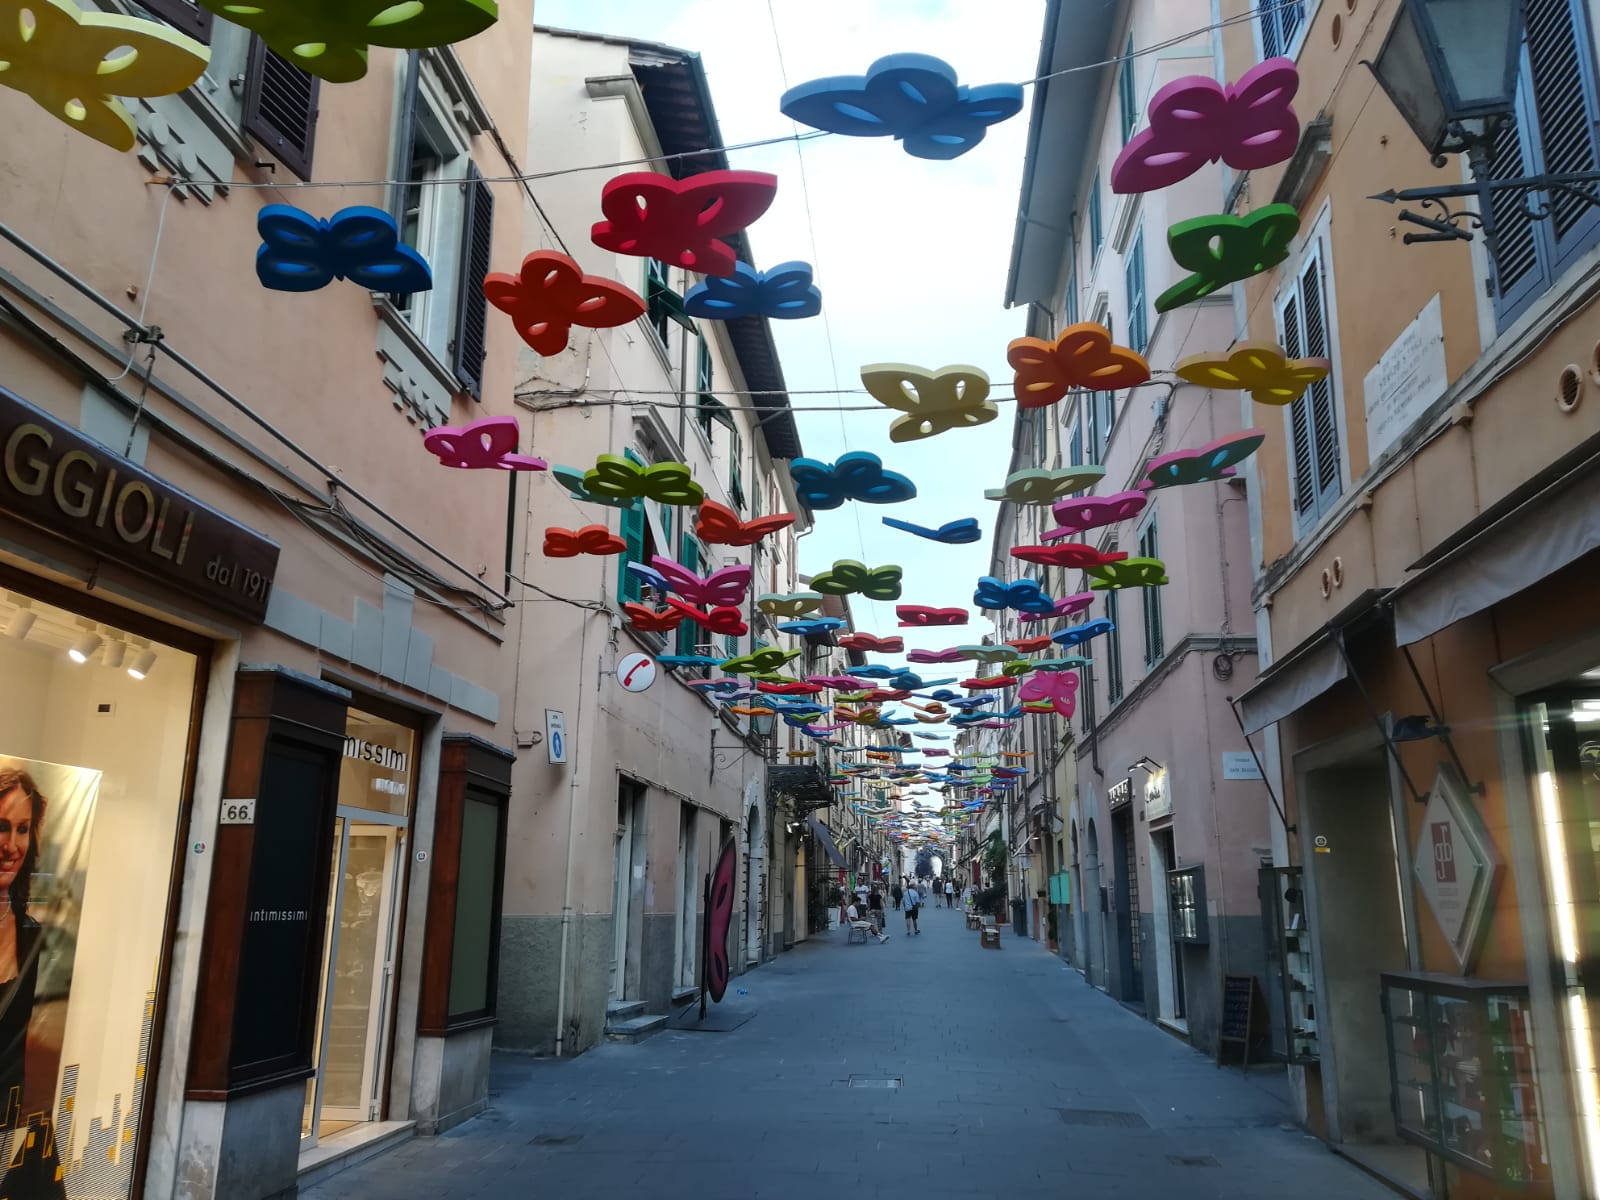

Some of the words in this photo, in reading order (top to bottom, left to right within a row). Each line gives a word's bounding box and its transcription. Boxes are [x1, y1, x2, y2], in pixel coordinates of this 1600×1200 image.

[207, 553, 238, 588] dal
[228, 804, 248, 820] 66
[250, 909, 308, 922] intimissimi
